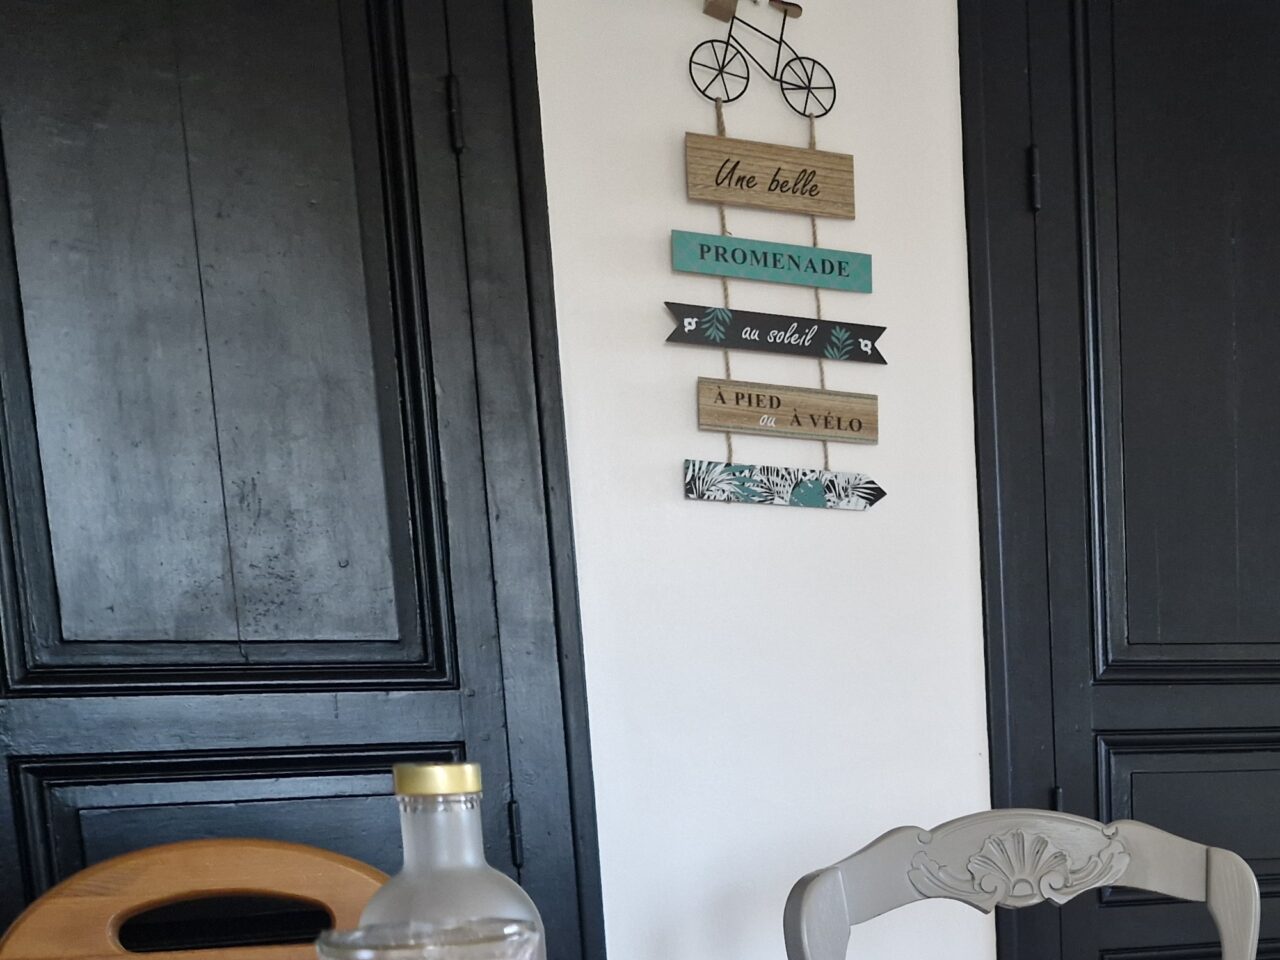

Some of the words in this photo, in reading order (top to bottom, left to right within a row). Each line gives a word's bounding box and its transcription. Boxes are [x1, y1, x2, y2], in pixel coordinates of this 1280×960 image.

[715, 158, 758, 189] Une
[768, 168, 821, 197] belle
[698, 243, 850, 278] PROMENADE
[741, 326, 760, 341] au
[767, 322, 818, 346] soleil
[714, 386, 726, 405] À
[735, 391, 781, 409] PIED
[759, 414, 777, 428] ou
[790, 408, 802, 427] À
[809, 411, 863, 432] VÉLO
